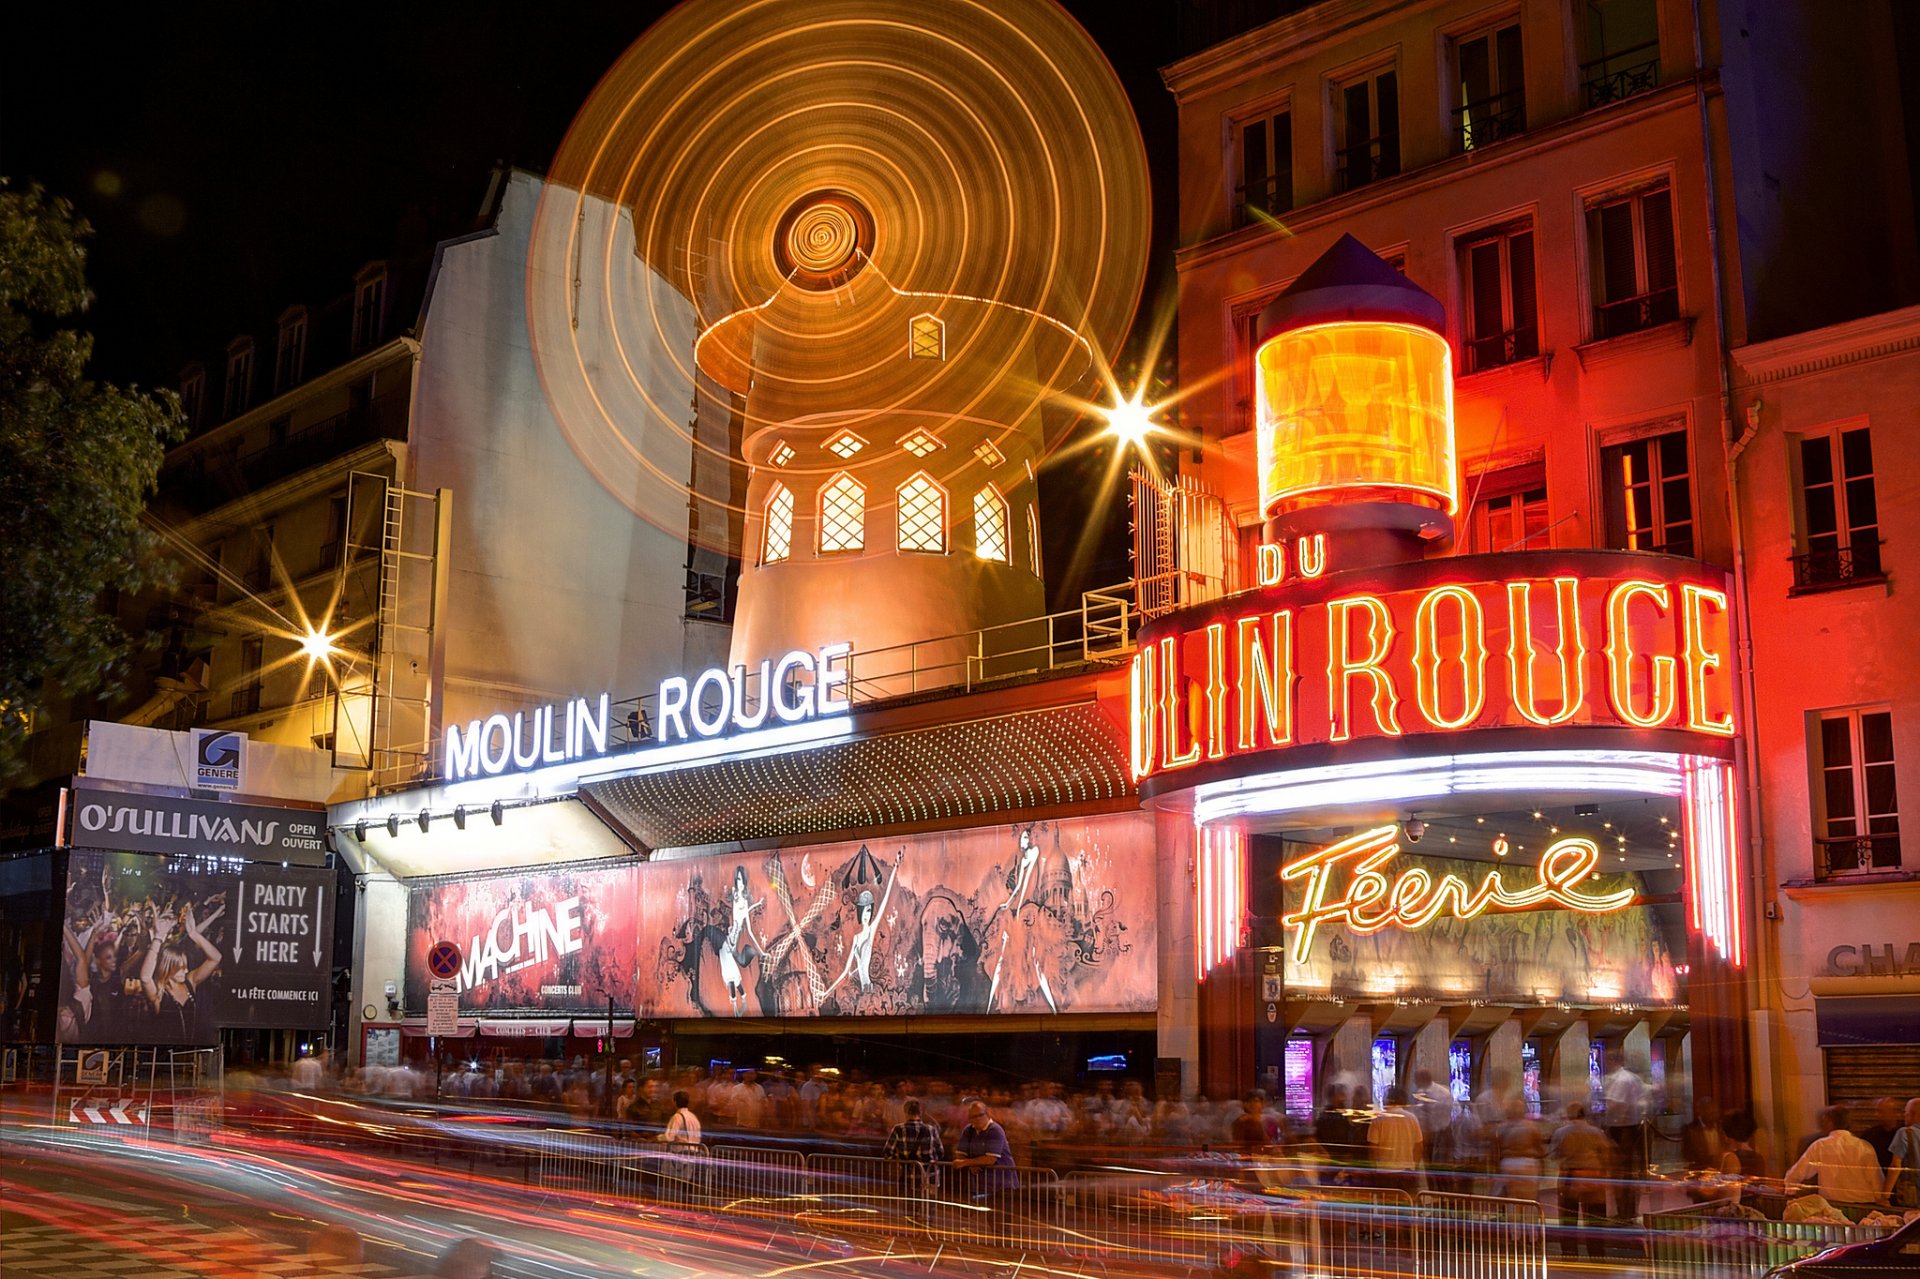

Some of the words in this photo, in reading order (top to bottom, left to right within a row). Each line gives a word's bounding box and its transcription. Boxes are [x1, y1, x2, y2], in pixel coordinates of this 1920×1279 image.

[1258, 534, 1325, 586] DU
[1327, 577, 1735, 742] ROUGE
[445, 690, 611, 782] MOULIN
[658, 641, 853, 744] ROUGE
[197, 767, 240, 779] GENERE
[80, 804, 280, 846] O'SULLIVANS
[289, 823, 317, 836] OPEN
[281, 836, 323, 851] OUVERT
[254, 883, 307, 908] PARTY
[1282, 824, 1636, 965] Féerie
[248, 911, 309, 936] STARTS
[256, 940, 299, 963] HERE
[455, 896, 583, 994] MACHINE
[237, 988, 247, 999] LA
[248, 986, 266, 1000] FÊTE
[267, 989, 307, 1001] COMMENCE
[308, 991, 319, 1001] ICI
[541, 985, 567, 995] CONCERTS
